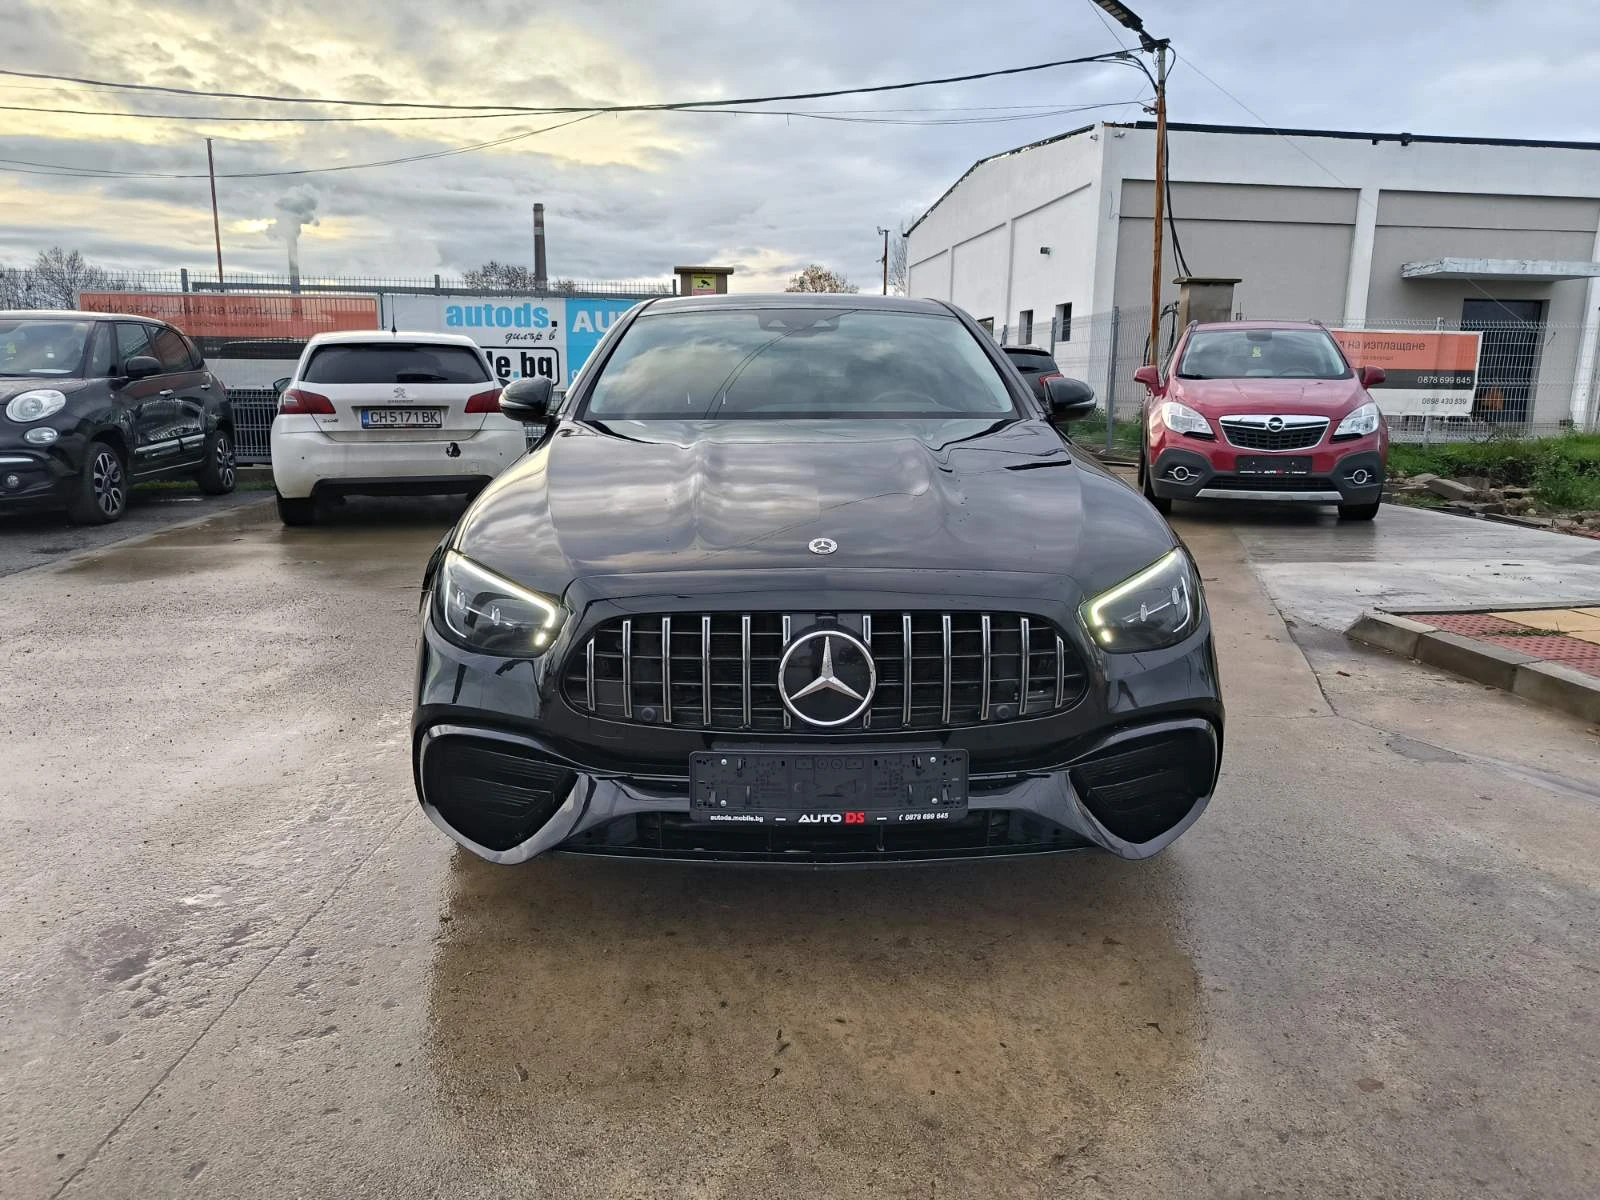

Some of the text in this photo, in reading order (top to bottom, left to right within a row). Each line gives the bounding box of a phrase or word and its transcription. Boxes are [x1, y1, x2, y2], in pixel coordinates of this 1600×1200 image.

[572, 310, 623, 333] AU
[1348, 340, 1361, 349] на
[1364, 341, 1426, 352] изплащане
[1417, 376, 1471, 385] 0878 699 645
[798, 814, 842, 823] AUTO
[845, 812, 865, 824] DS
